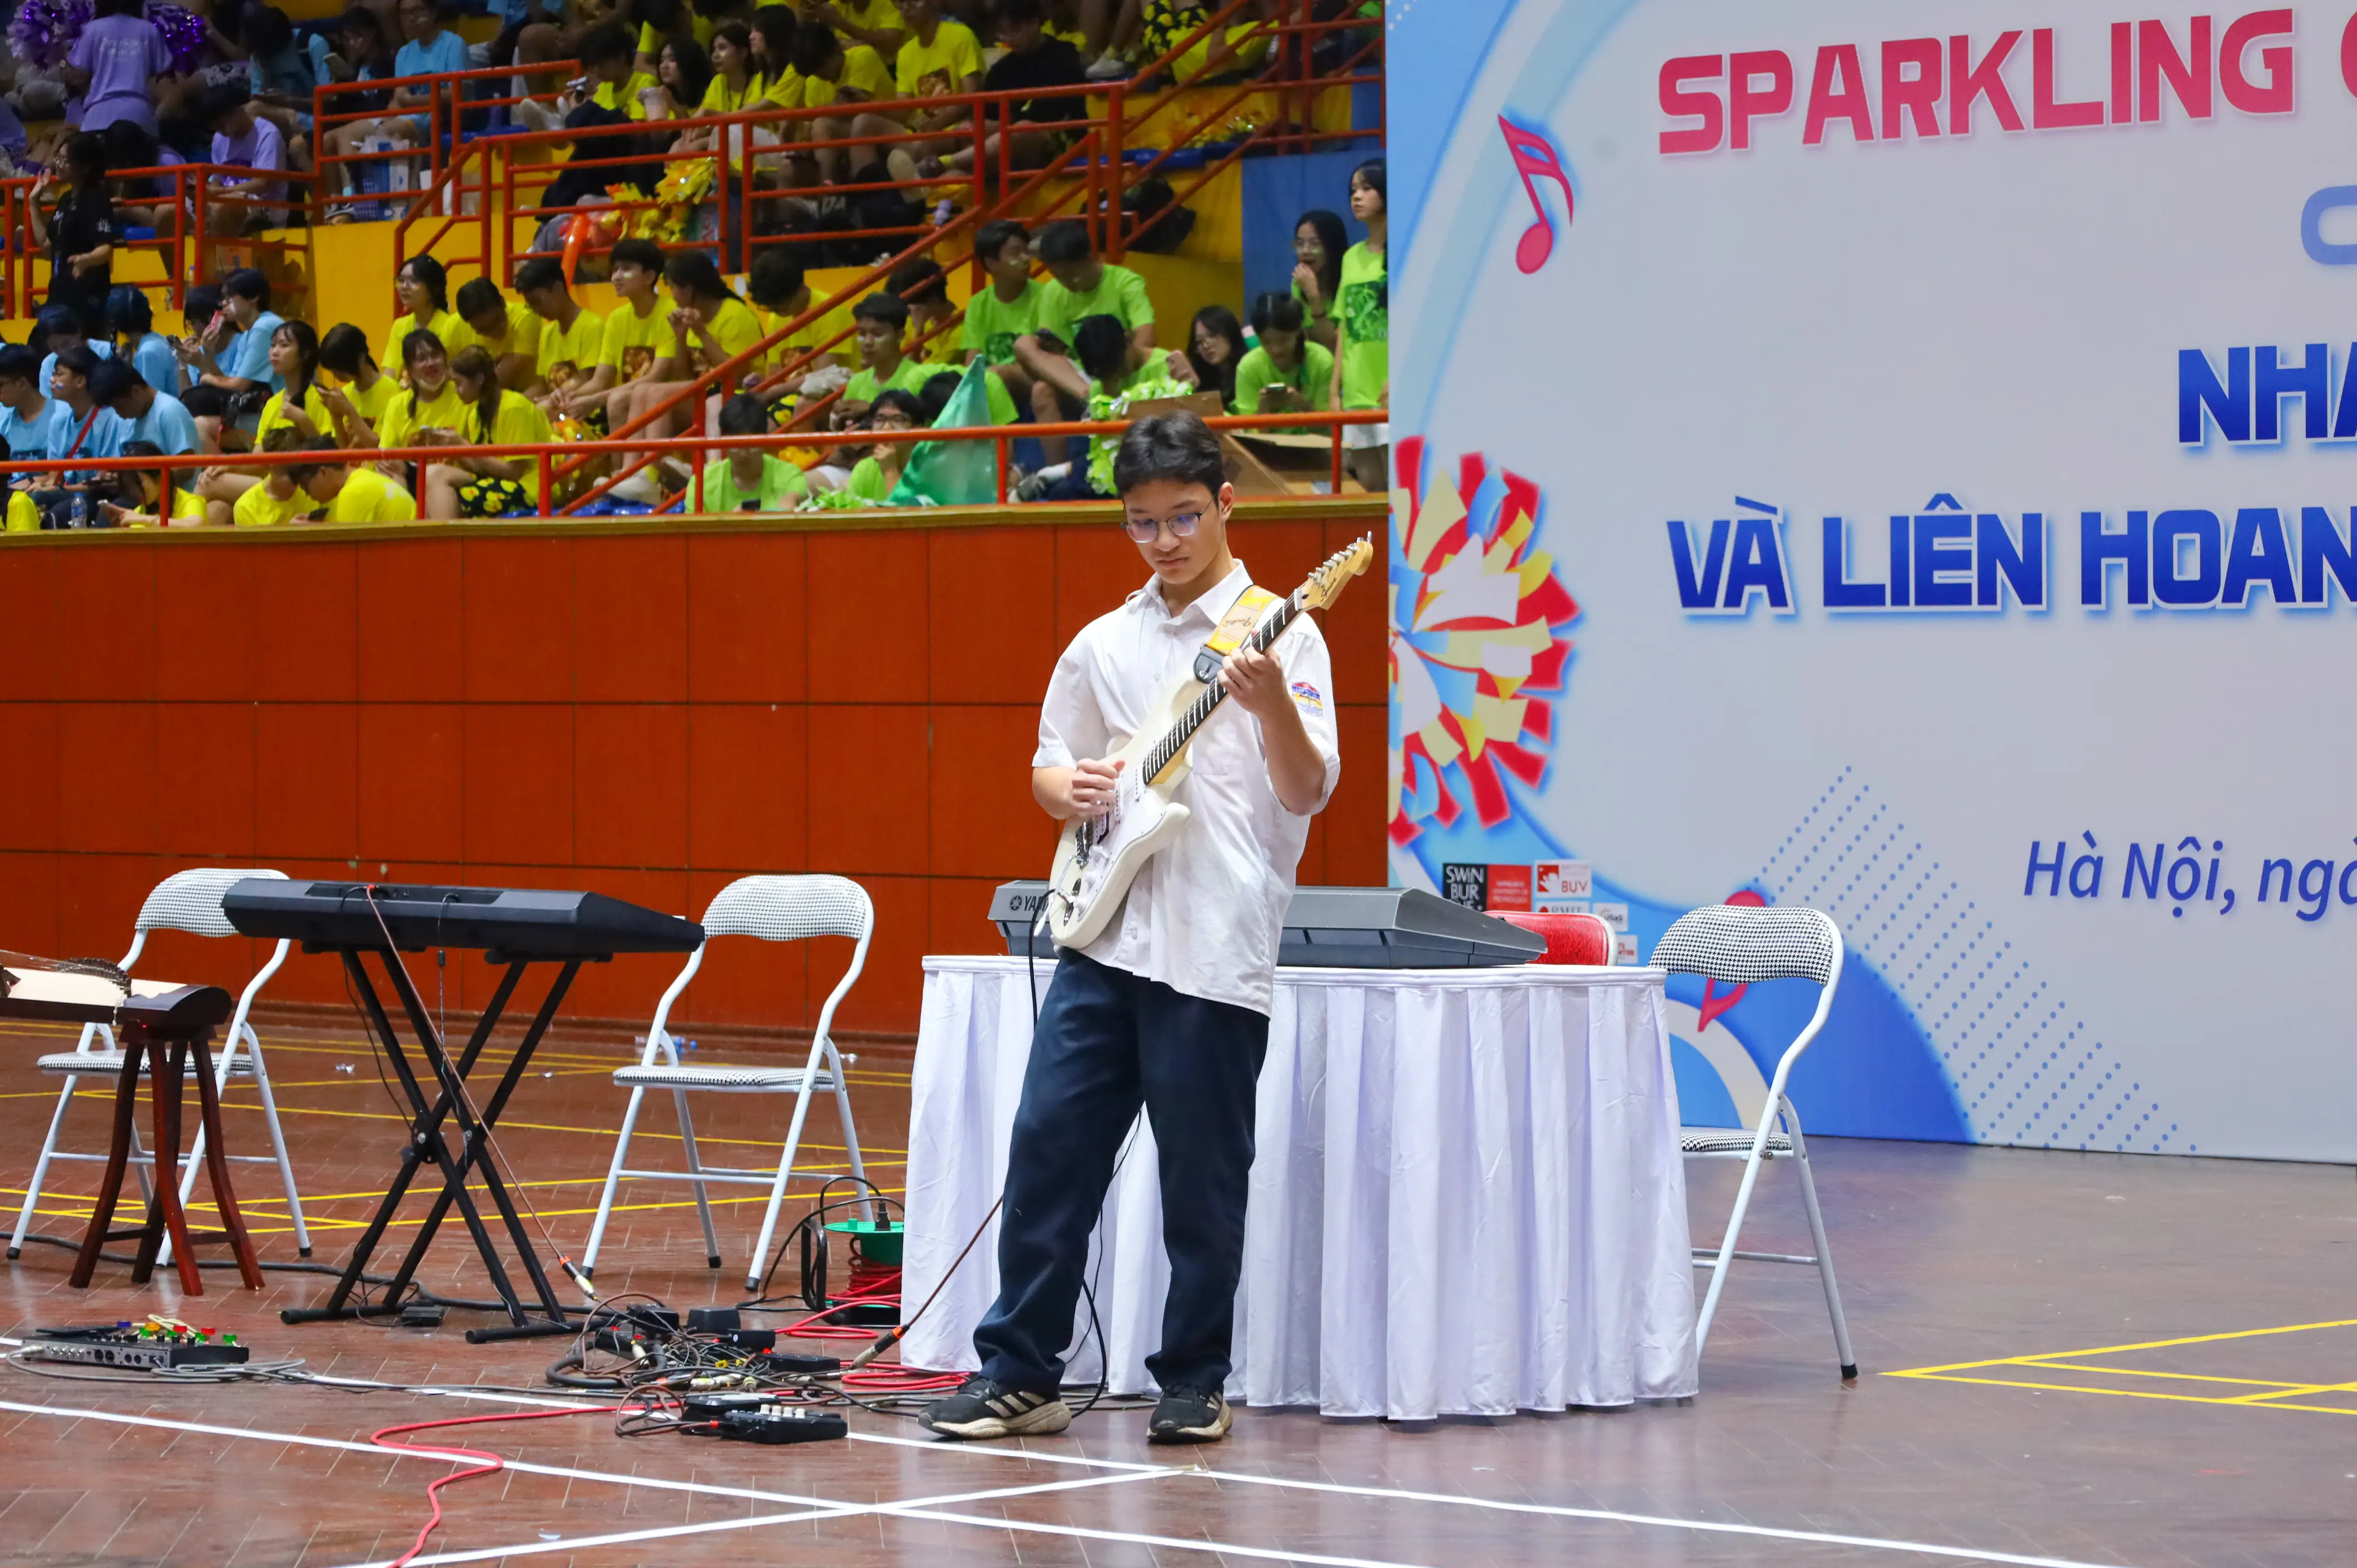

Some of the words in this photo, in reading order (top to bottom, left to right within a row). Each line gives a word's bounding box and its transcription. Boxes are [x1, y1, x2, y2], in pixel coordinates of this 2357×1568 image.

[1659, 9, 2294, 154] SPARKLING
[1667, 496, 1788, 608] VÀ
[1823, 493, 2042, 606] LIÊN
[1446, 866, 1484, 883] SWIN
[1450, 883, 1480, 900] BUR
[1562, 881, 1588, 893] BUV
[2024, 830, 2104, 898] Hà
[2122, 836, 2236, 918] Nội,
